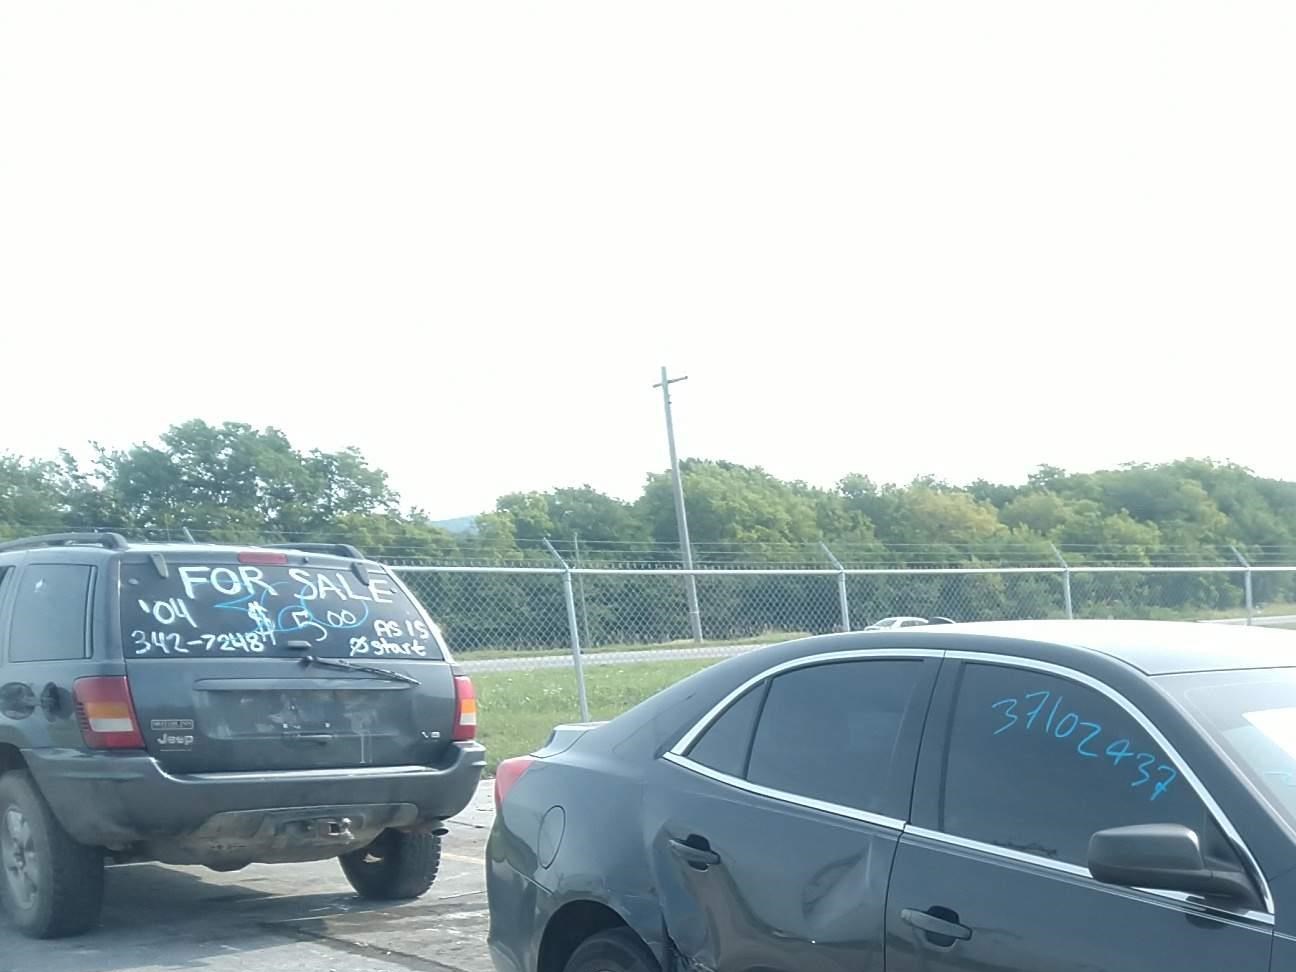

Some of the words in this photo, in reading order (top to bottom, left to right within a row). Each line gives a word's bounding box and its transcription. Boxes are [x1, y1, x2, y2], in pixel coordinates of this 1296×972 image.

[178, 565, 278, 599] FOR
[288, 568, 393, 604] SALE
[374, 619, 403, 638] AS
[131, 630, 265, 655] 342-7248
[157, 733, 194, 746] Jeep
[992, 691, 1178, 801] 37102437
